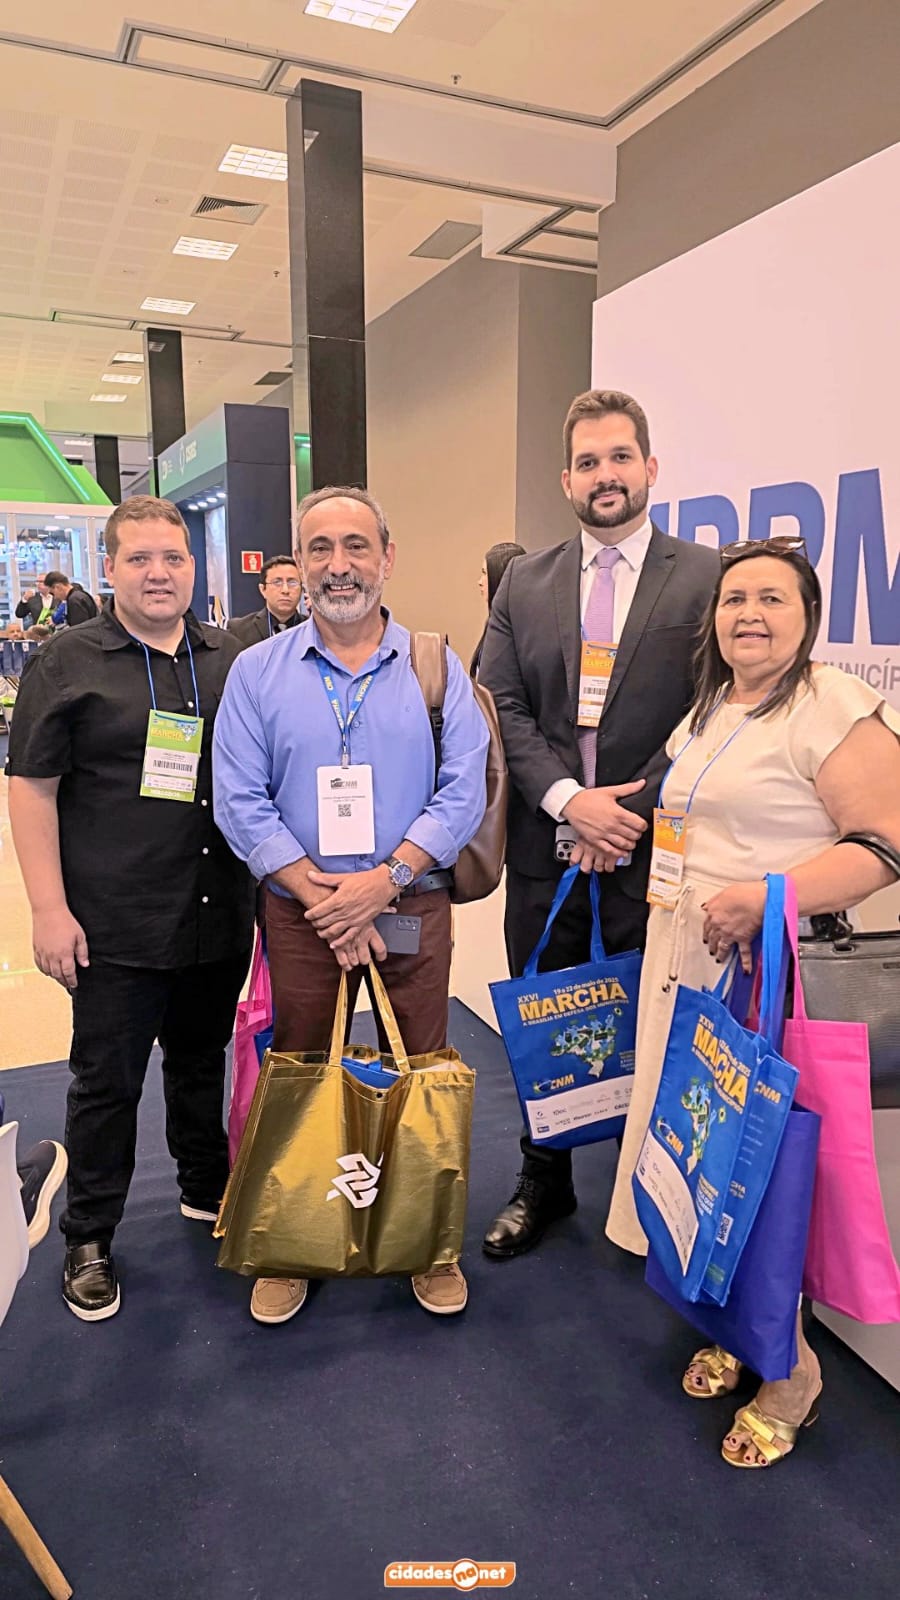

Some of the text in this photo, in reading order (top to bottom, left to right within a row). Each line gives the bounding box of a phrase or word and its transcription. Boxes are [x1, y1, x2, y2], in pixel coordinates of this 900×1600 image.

[517, 993, 538, 1004] XXVI
[518, 982, 628, 1022] MARCHA
[551, 1074, 574, 1090] CNM
